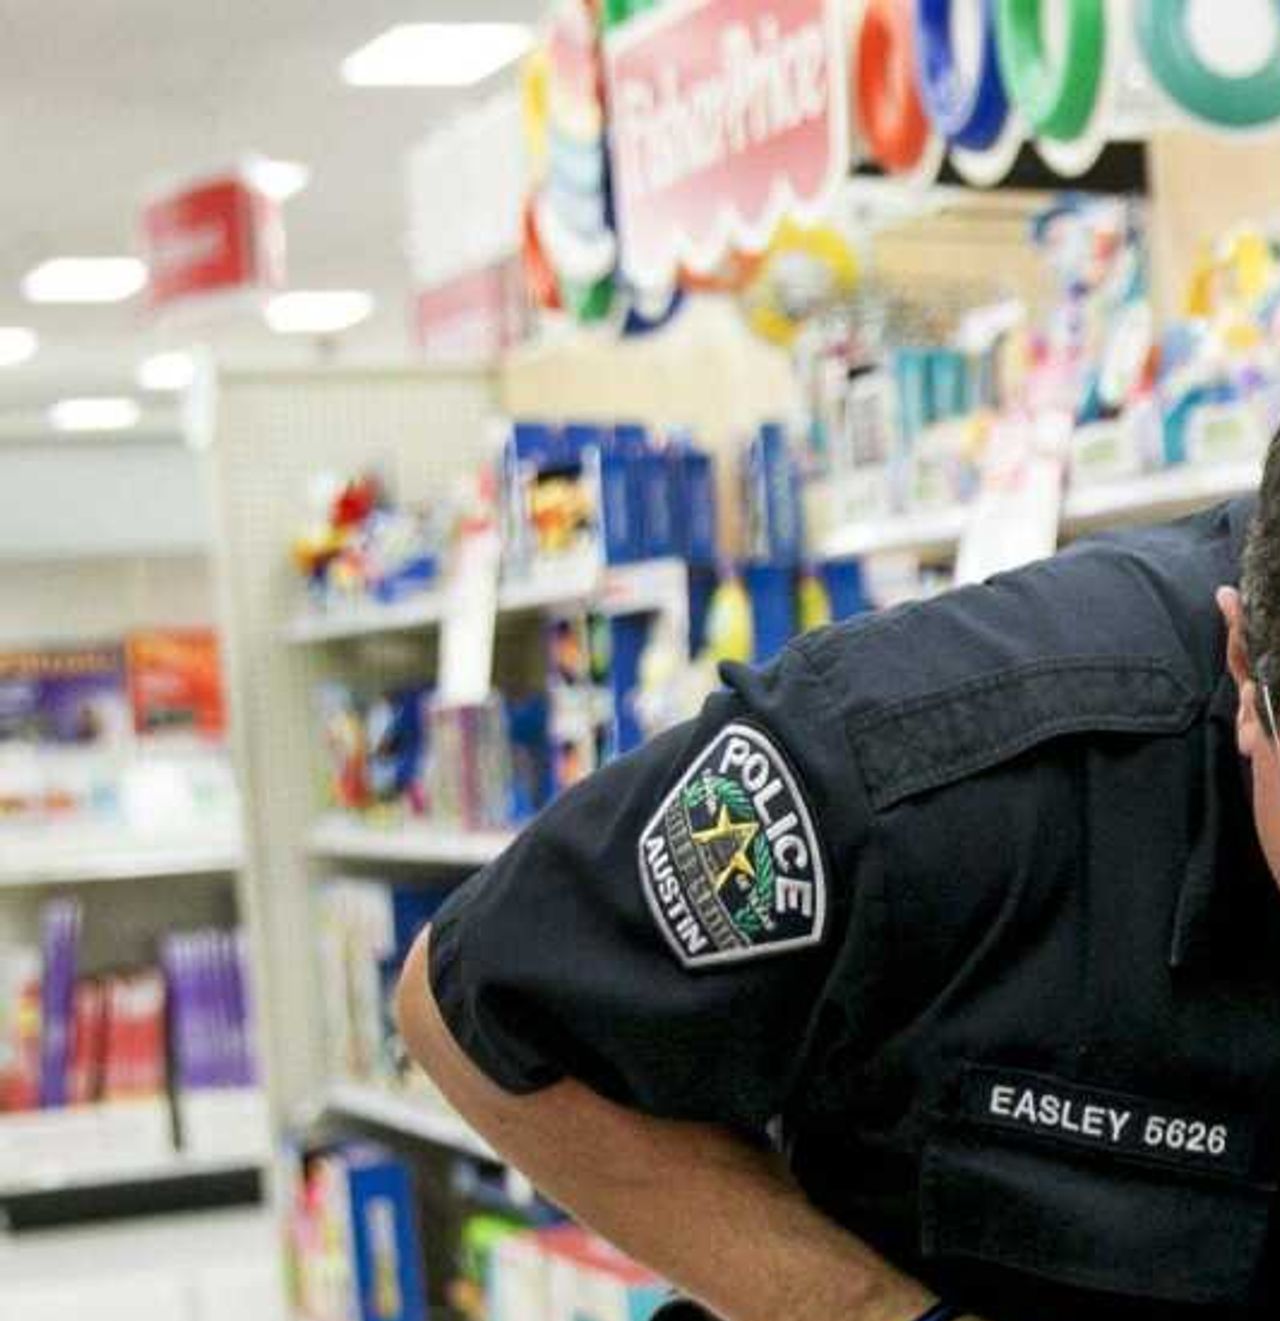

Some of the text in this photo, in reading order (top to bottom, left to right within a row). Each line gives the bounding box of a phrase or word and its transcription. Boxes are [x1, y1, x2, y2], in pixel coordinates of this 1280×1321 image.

[719, 737, 812, 917] POLICE
[646, 835, 707, 954] AUSTIN
[989, 1084, 1227, 1154] EASLEY 5626
